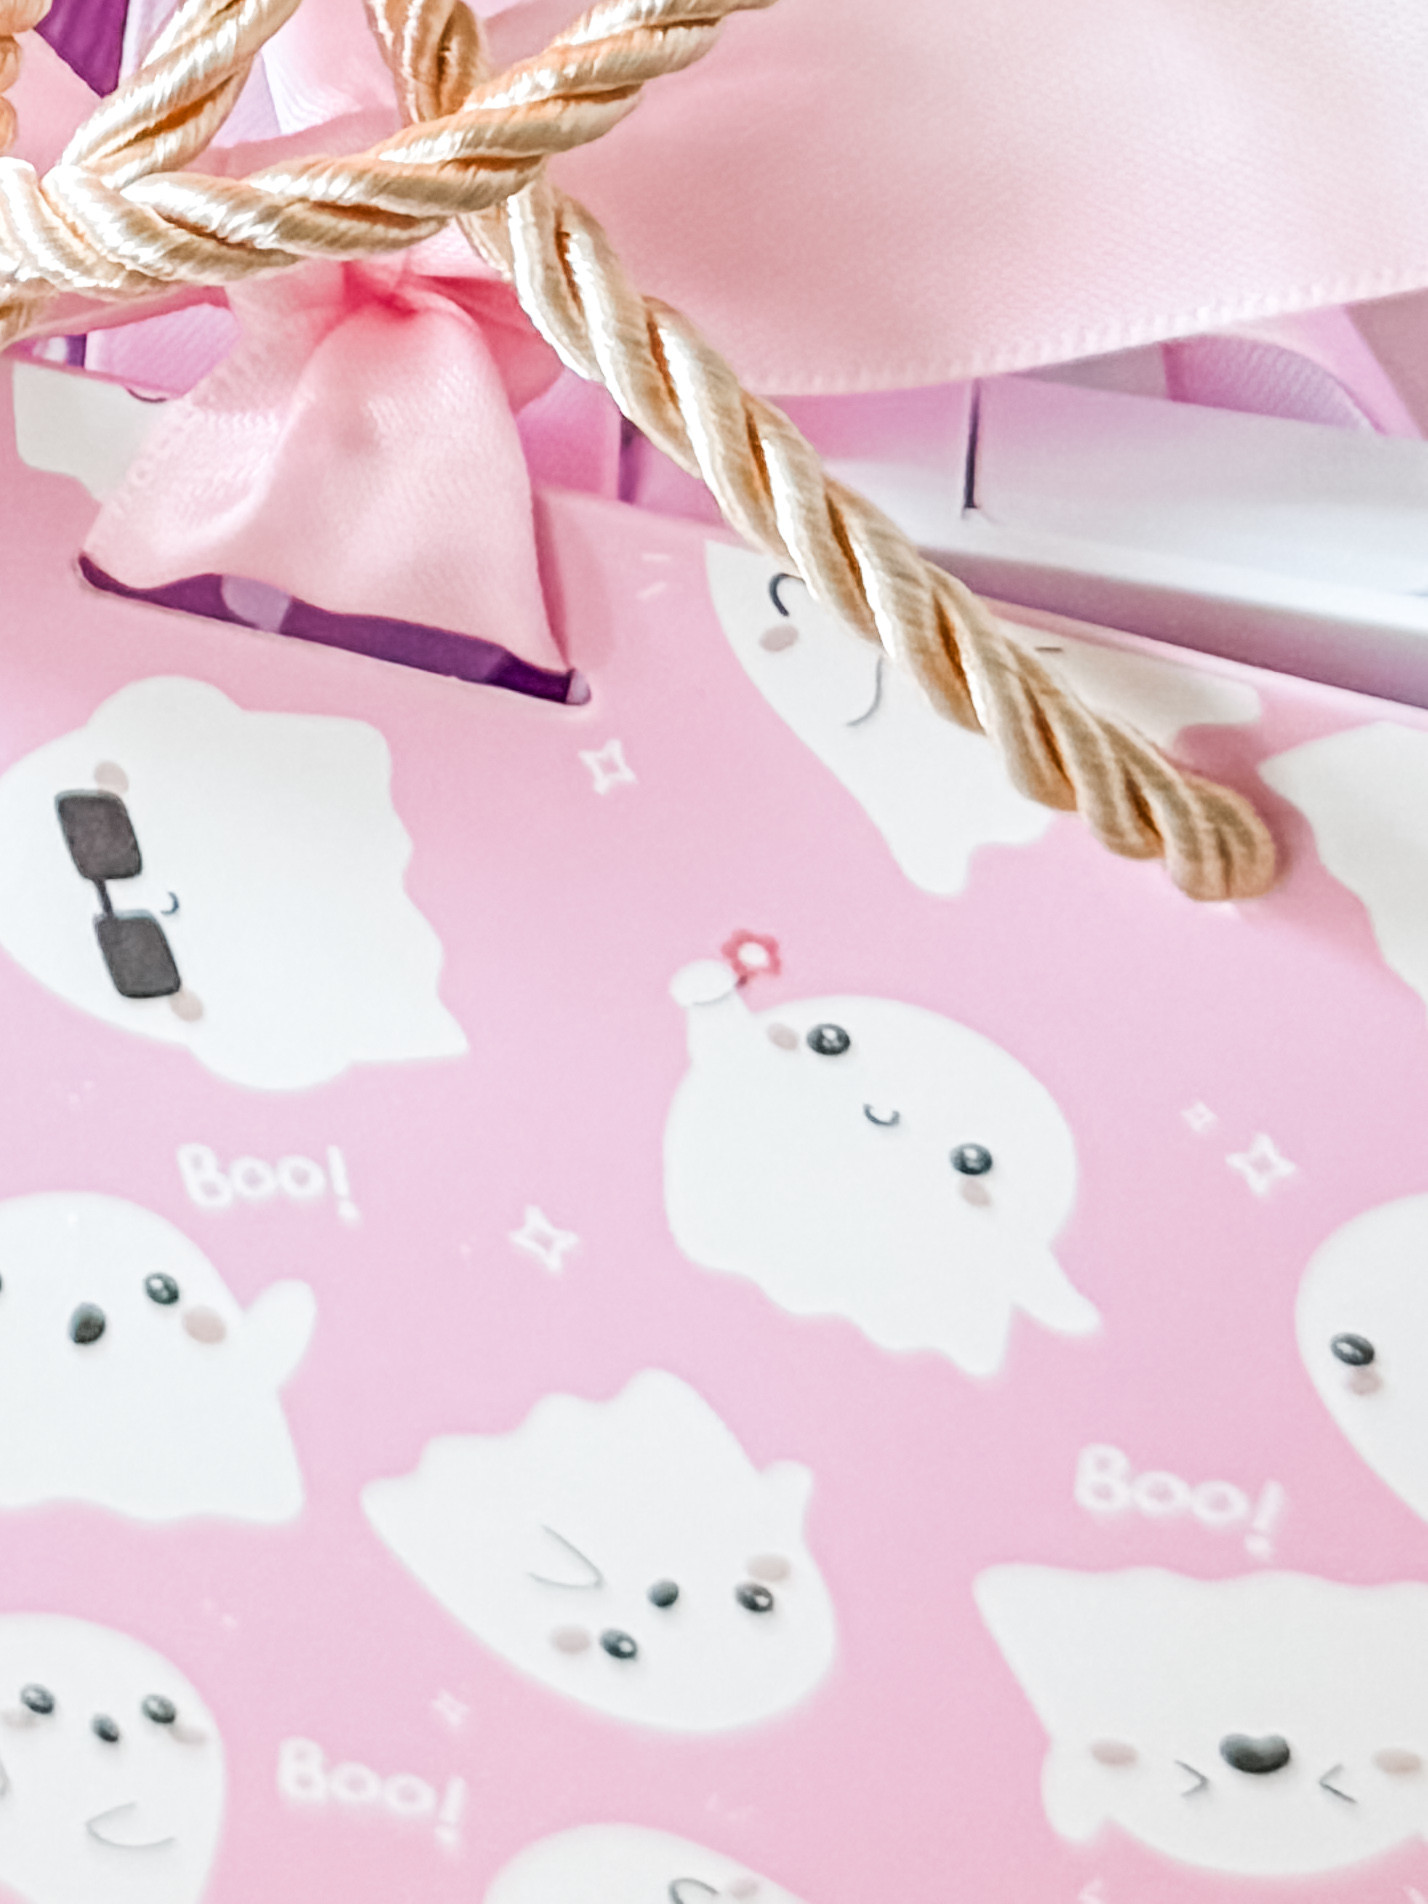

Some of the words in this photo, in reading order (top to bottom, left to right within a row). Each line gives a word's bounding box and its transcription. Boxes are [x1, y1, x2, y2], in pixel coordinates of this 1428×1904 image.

[180, 1142, 360, 1222] Boo!
[1072, 1444, 1286, 1554] Boo!
[276, 1738, 470, 1850] Boo!
